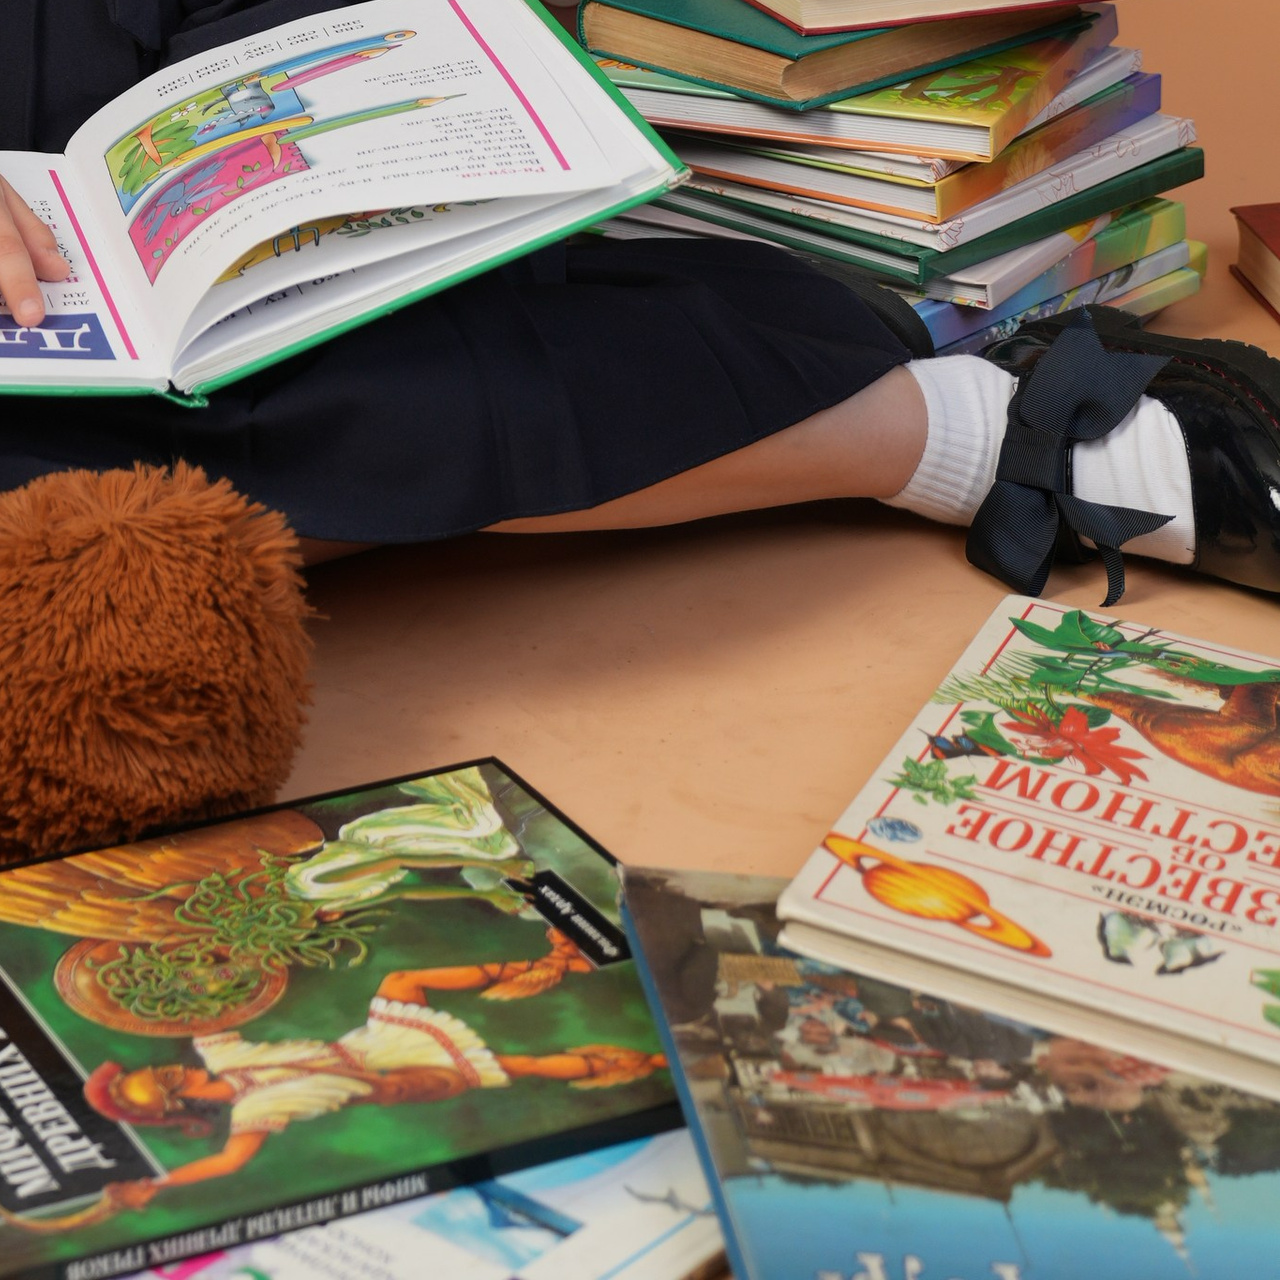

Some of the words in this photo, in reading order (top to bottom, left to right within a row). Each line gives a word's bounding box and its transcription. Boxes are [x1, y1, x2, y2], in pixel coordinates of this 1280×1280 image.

[1169, 843, 1227, 872] ОБ
[341, 1194, 360, 1221] И
[360, 1172, 430, 1210] МИФЫ
[246, 1194, 340, 1239] ЛЕГЕНДЫ
[146, 1217, 242, 1264] ДРЕВНИХ
[65, 1246, 147, 1280] ГРЕКОВ
